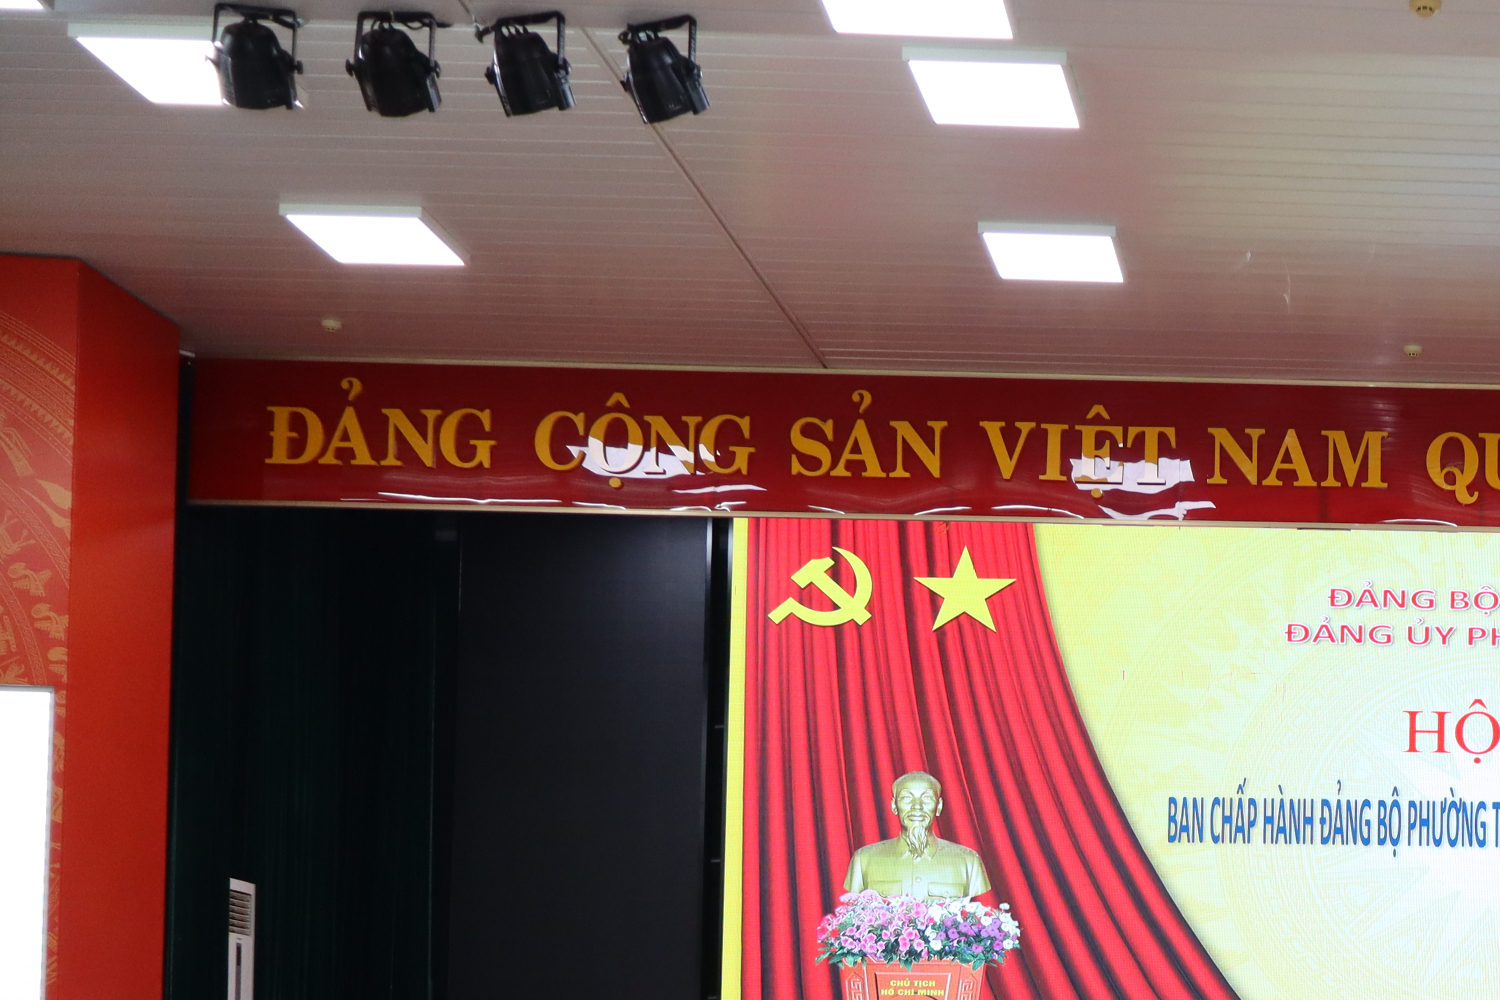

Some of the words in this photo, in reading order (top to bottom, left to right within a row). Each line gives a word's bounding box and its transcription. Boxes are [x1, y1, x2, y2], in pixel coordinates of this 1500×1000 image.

[264, 376, 498, 470] ĐẢNG
[534, 391, 757, 489] CỘNG
[789, 389, 946, 480] SẢN
[979, 404, 1178, 498] VIỆT
[1206, 426, 1389, 490] NAM
[1326, 580, 1437, 611] ĐẢNG
[1448, 585, 1500, 617] BỘ
[1285, 616, 1394, 647] ĐẢNG
[1406, 618, 1456, 647] ỦY
[1166, 795, 1205, 844] BAN
[1210, 777, 1258, 845] CHẤP
[1263, 783, 1314, 845] HÀNH
[1319, 779, 1371, 847] ĐẢNG
[1377, 786, 1402, 858] BỘ
[1407, 787, 1487, 848] PHƯỜNG
[914, 979, 936, 988] TỊCH
